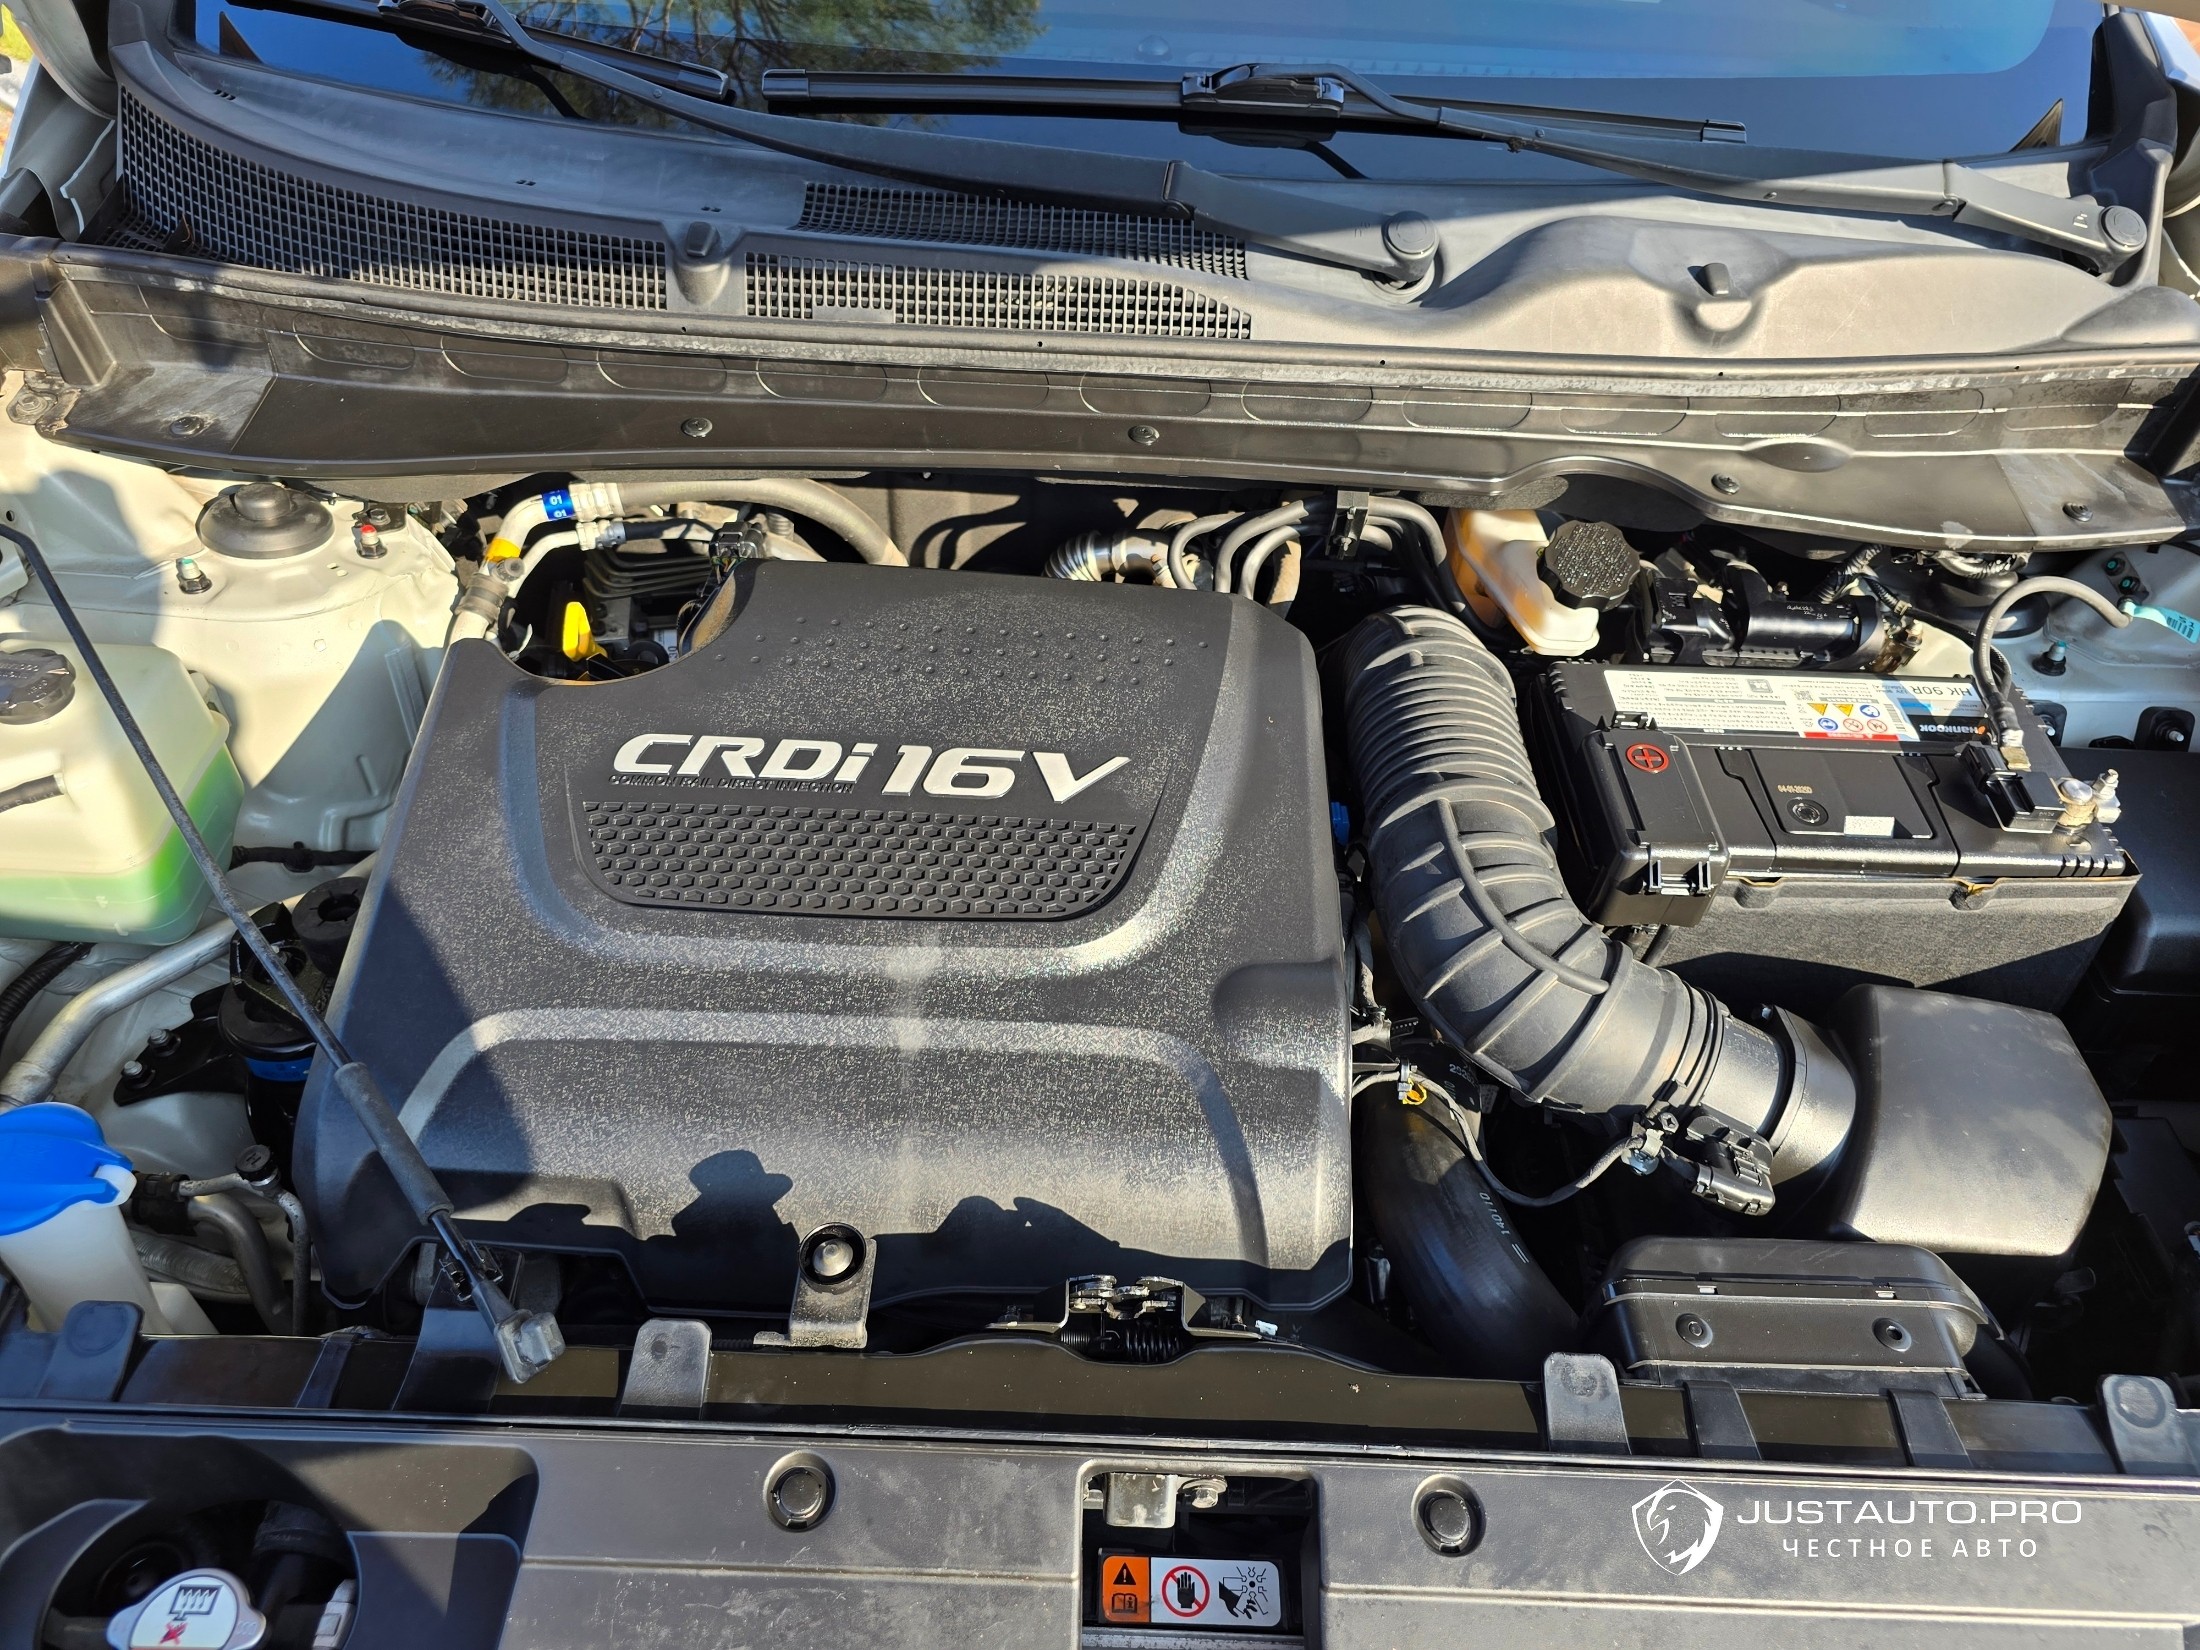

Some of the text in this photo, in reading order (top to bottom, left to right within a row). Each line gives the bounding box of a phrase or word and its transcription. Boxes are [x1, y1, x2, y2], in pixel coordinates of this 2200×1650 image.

[1911, 685, 1944, 696] 90R
[1947, 686, 1973, 697] HK
[612, 733, 1132, 803] CRDi 16V
[608, 774, 855, 794] COMMON RAIL DIRECT INJECTION
